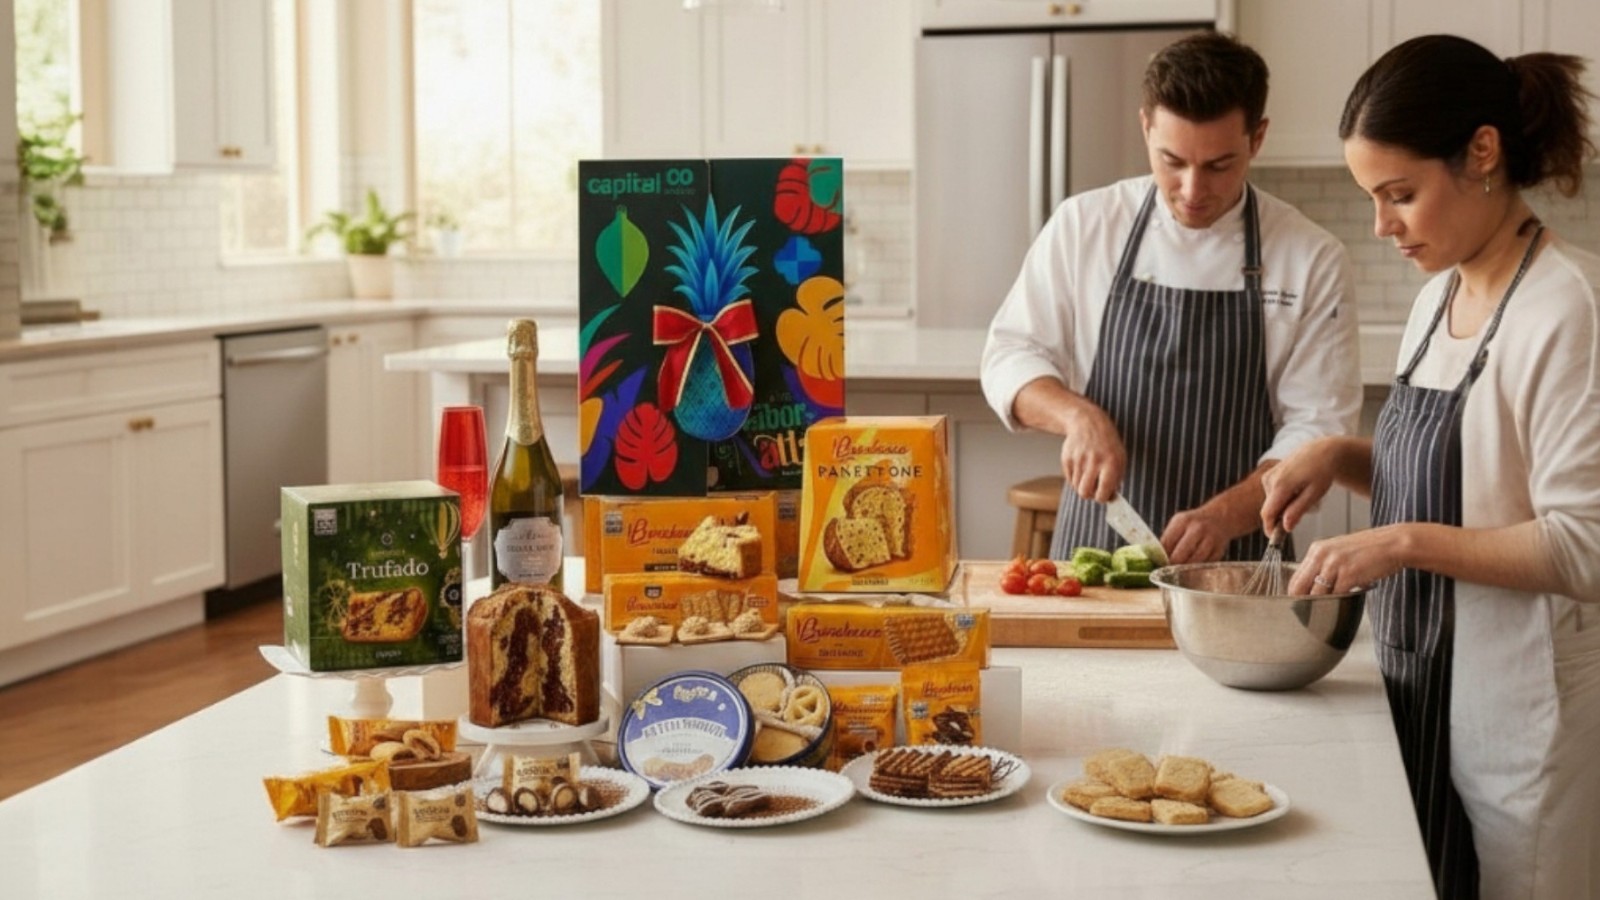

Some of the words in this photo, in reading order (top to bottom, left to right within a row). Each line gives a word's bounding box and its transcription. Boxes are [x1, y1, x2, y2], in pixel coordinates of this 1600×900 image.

[587, 172, 662, 200] capital
[818, 465, 923, 479] PANETTONE
[347, 557, 430, 580] Trufado
